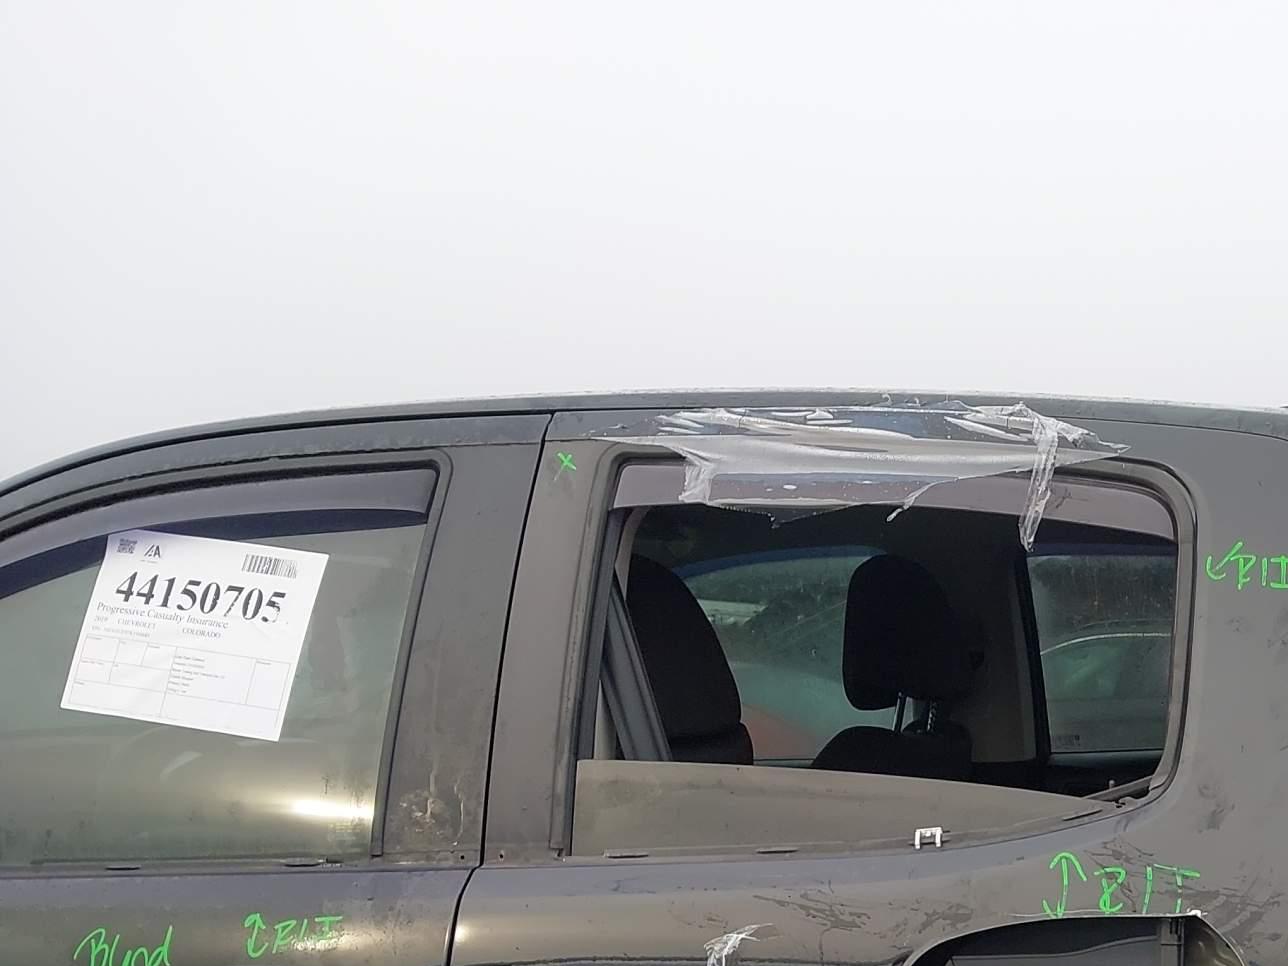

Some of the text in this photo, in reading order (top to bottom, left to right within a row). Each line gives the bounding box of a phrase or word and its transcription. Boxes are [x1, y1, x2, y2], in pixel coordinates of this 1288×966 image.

[115, 571, 287, 624] 44150705
[97, 601, 229, 629] Progressive Casualty Insurance
[182, 627, 221, 639] COLORADO
